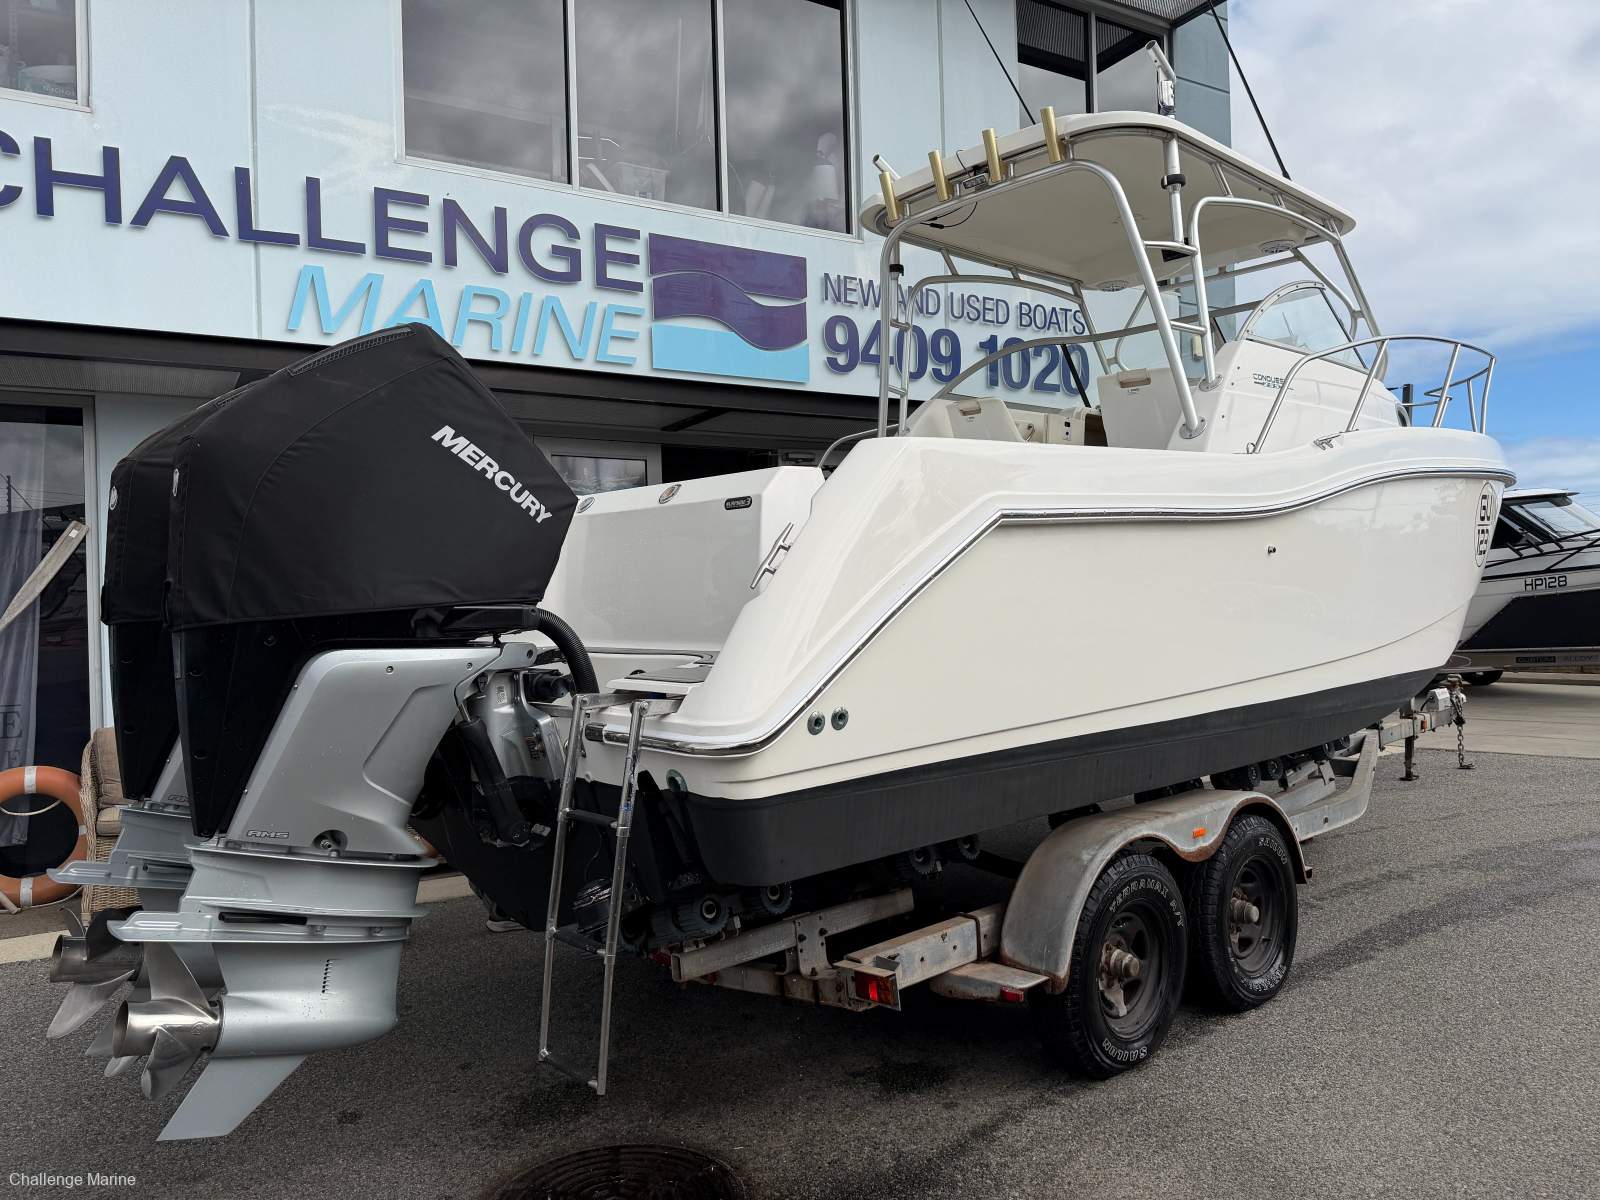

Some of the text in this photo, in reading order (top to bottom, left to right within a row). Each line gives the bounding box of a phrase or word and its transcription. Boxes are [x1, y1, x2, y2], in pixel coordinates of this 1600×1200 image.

[287, 264, 645, 365] MARINE
[823, 272, 881, 308] NEW
[950, 291, 1010, 325] USED
[1019, 301, 1086, 335] BOATS
[823, 315, 1090, 396] 9409 1020
[431, 425, 552, 523] MERCURY
[1524, 575, 1568, 591] HP128
[247, 830, 289, 839] AMS
